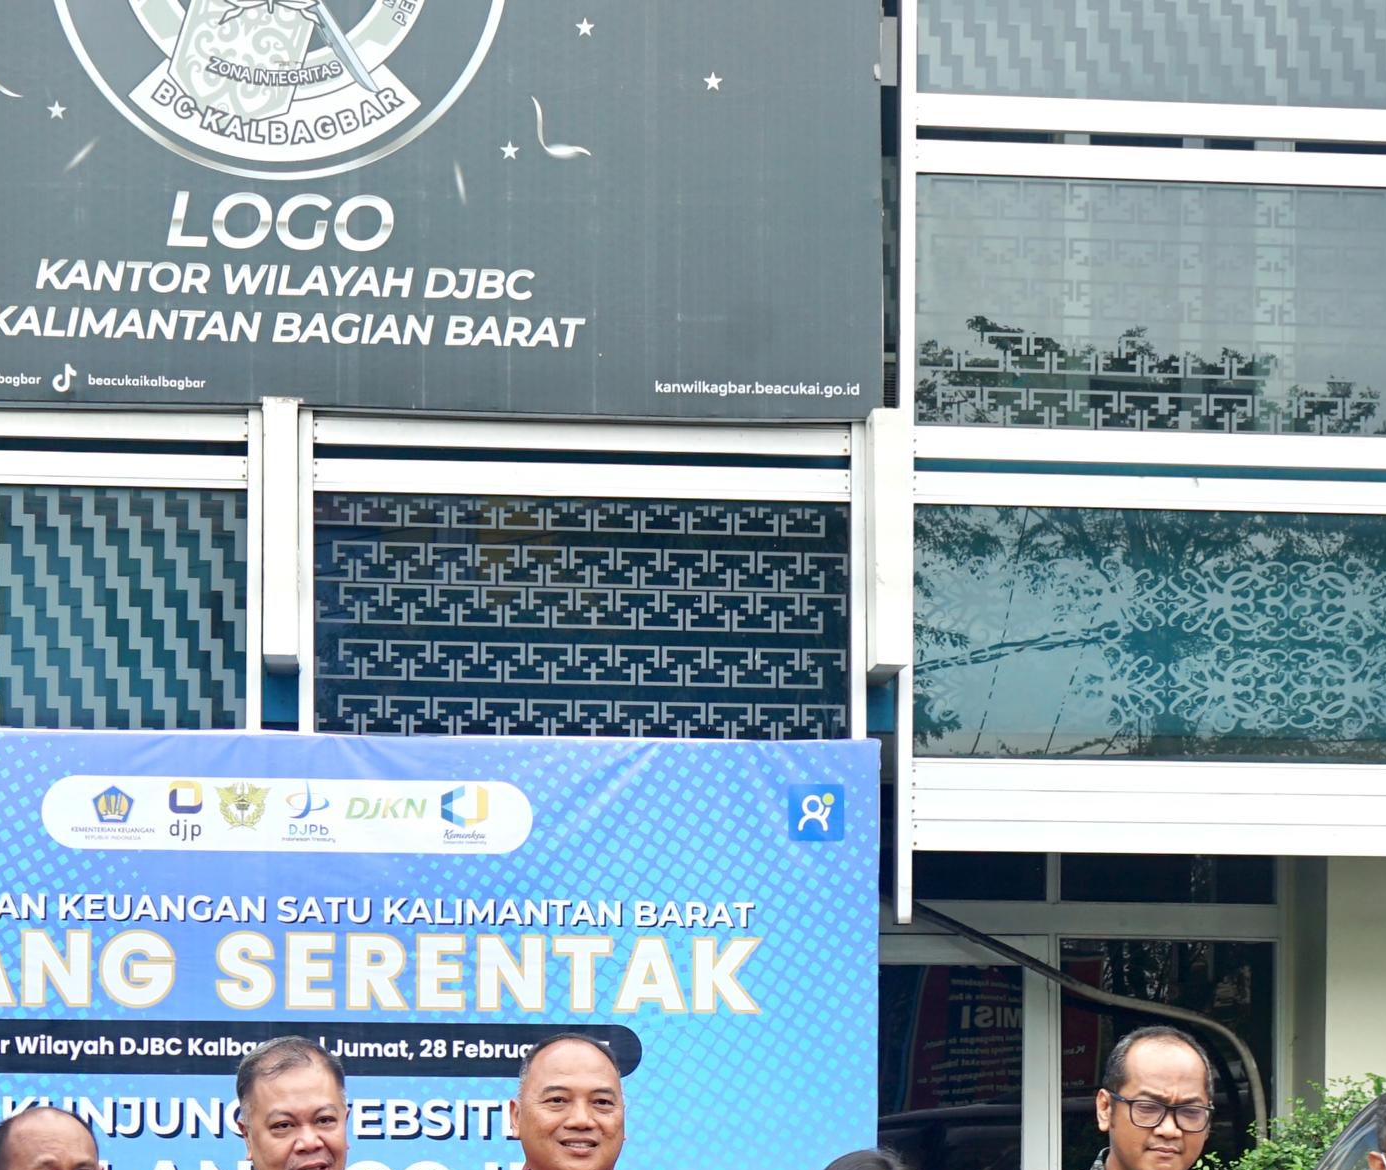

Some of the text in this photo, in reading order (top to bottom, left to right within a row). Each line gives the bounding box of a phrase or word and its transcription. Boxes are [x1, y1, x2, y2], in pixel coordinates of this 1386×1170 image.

[205, 56, 344, 86] ZONA INTEGRITAS
[151, 80, 405, 145] BC KALBAGBAR
[166, 190, 395, 252] LOGO
[35, 258, 535, 301] KANTOR WILAYAH DJBC
[271, 312, 435, 346] BAGIAN
[443, 316, 587, 349] BARAT
[88, 373, 207, 390] beacukaikalbagbar
[654, 380, 861, 398] kanwilkagbar.beacukai.go.id
[169, 819, 202, 841] djp
[288, 824, 329, 836] DJPb
[59, 893, 267, 924] KEUANGAN
[277, 896, 373, 925] SATU
[383, 897, 623, 928] KALIMANTAN
[635, 900, 757, 929] BARAT
[215, 930, 762, 1014] SERENTAK
[15, 1036, 115, 1061] Wilayah
[120, 1037, 182, 1056] DJBC
[188, 1037, 265, 1057] Kalba
[330, 1038, 414, 1060] Jumat,
[419, 1039, 447, 1059] 28
[452, 1040, 535, 1059] Februa
